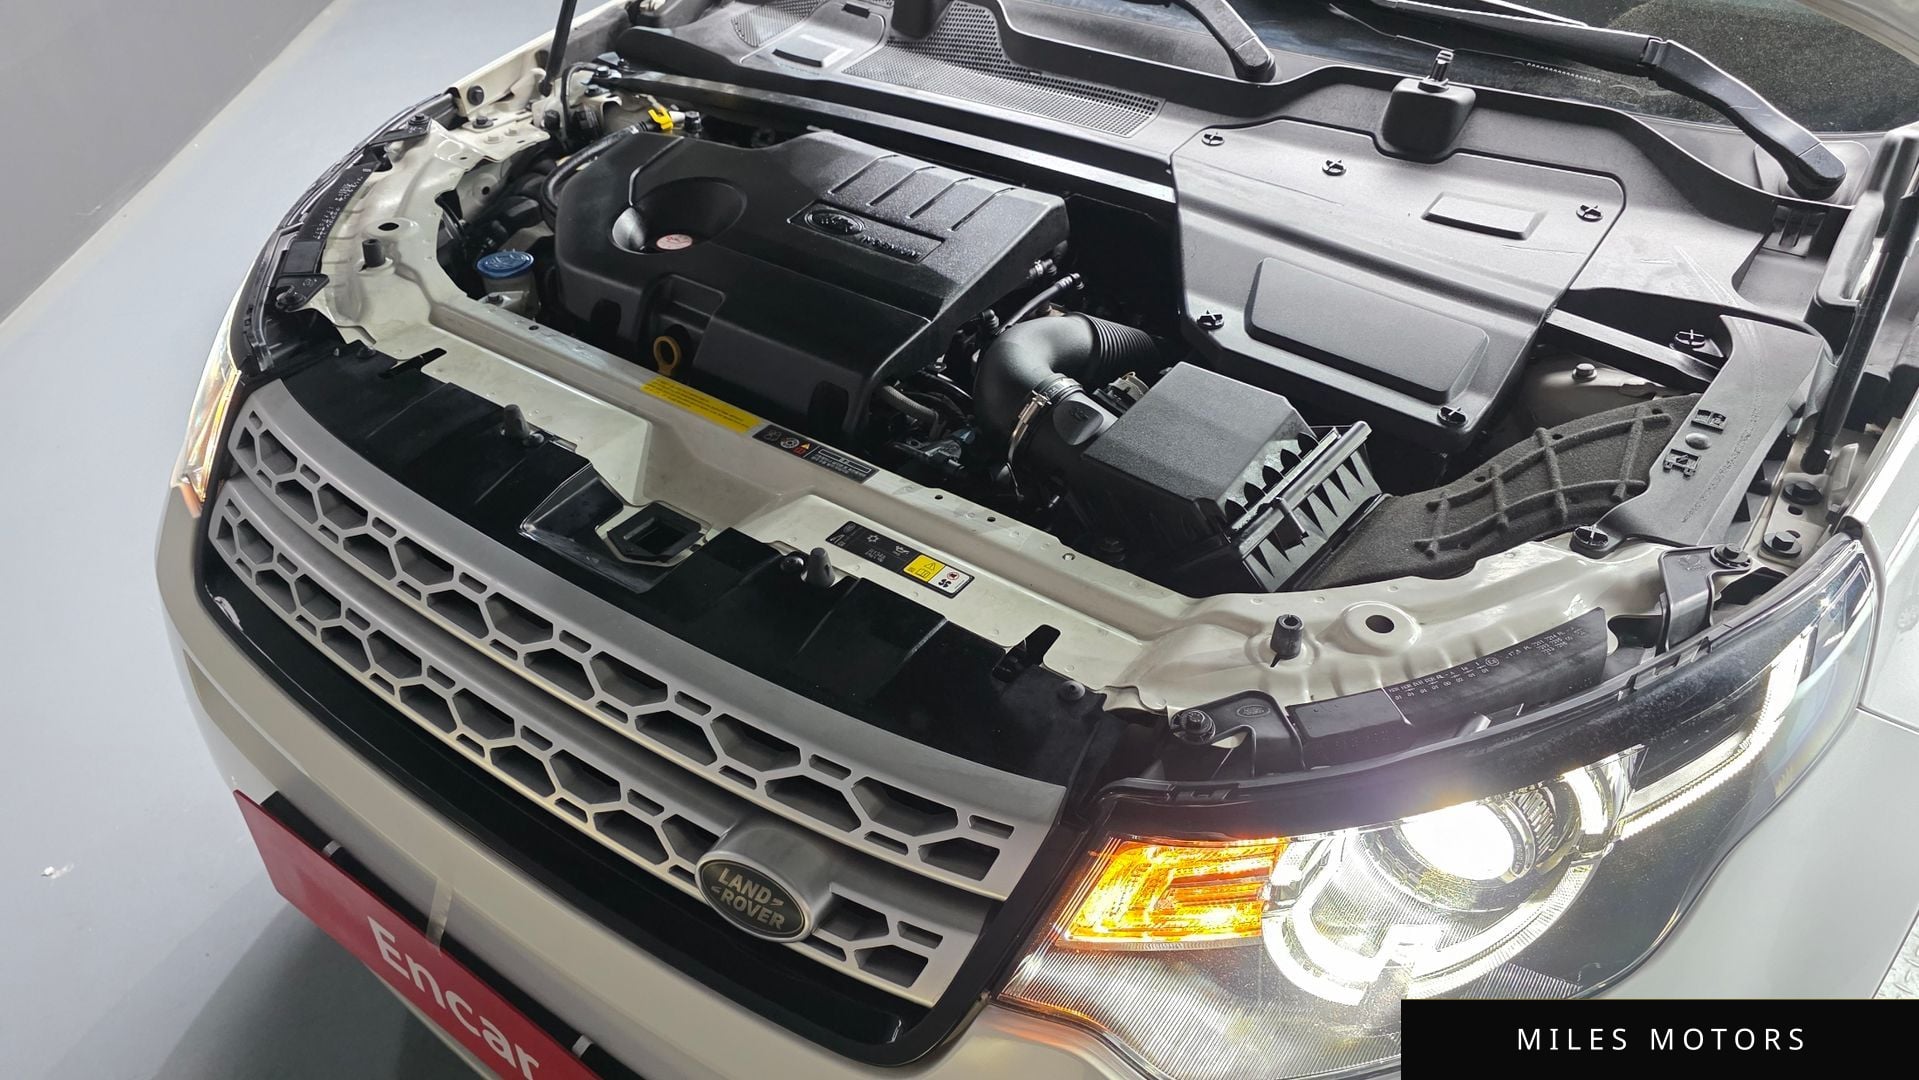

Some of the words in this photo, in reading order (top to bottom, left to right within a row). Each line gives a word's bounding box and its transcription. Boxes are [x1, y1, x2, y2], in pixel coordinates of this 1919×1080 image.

[718, 867, 772, 904] LAND
[720, 888, 785, 929] ROVER
[367, 915, 540, 1080] Encar
